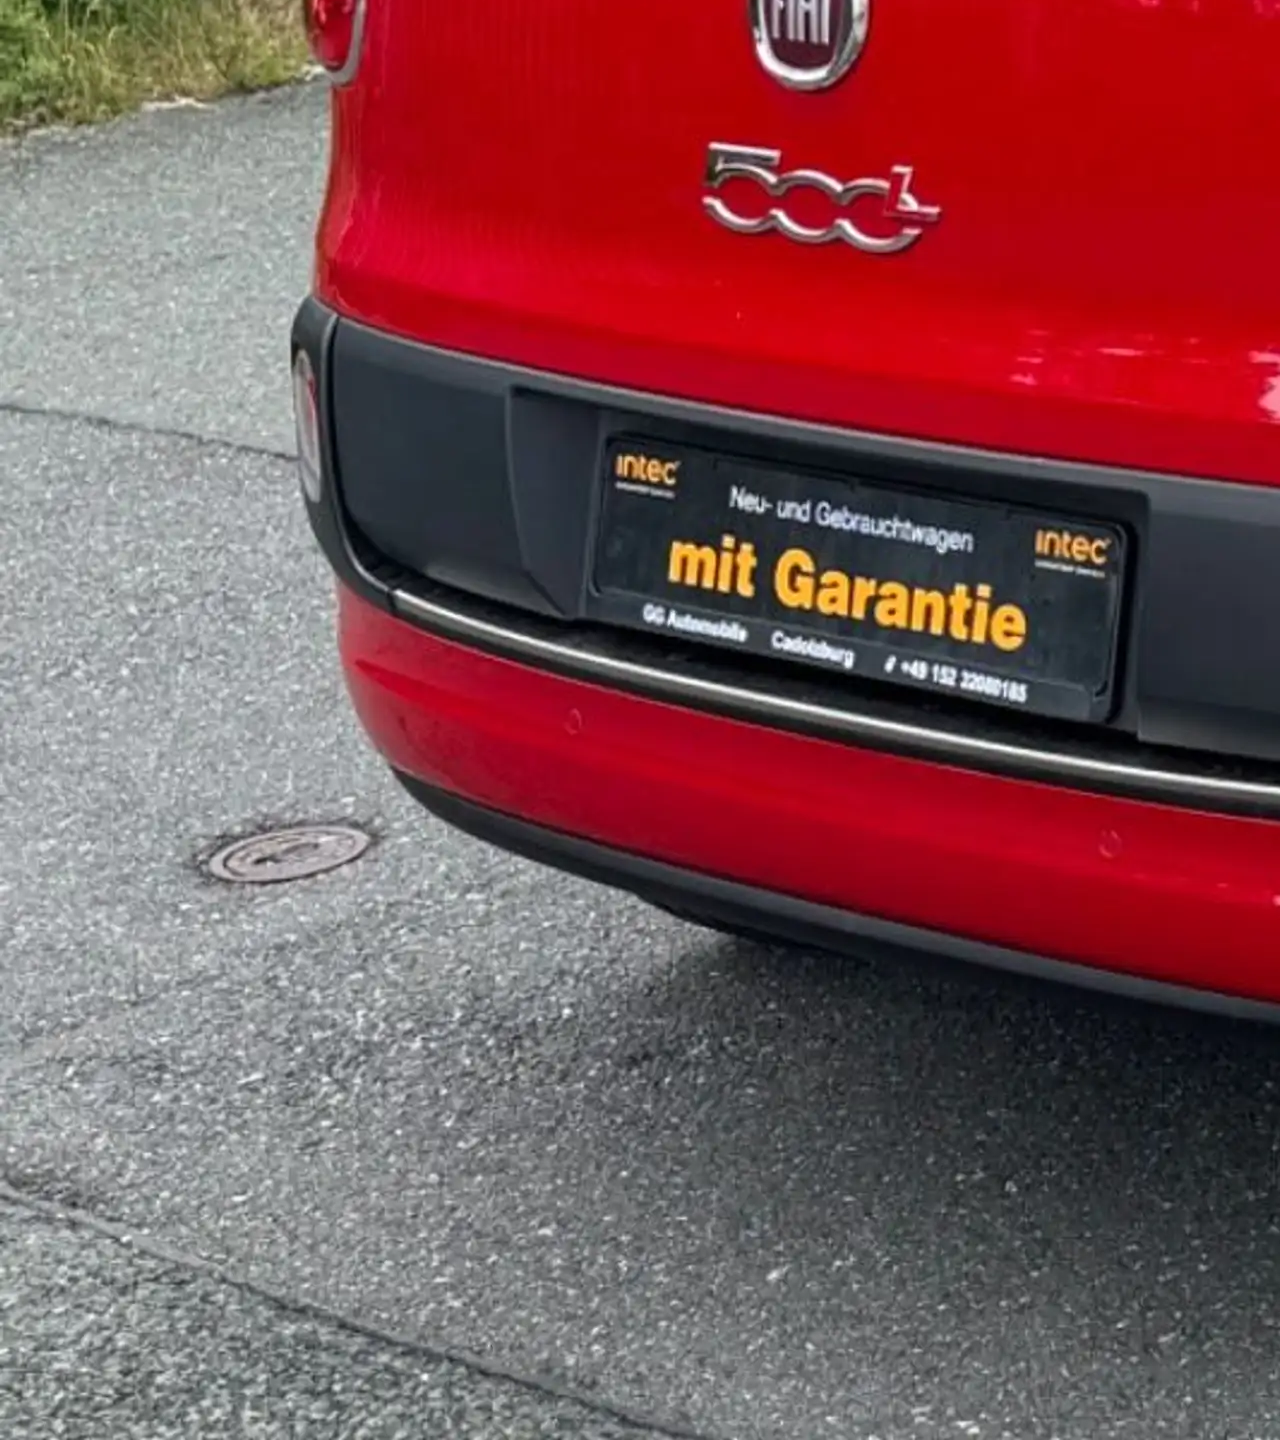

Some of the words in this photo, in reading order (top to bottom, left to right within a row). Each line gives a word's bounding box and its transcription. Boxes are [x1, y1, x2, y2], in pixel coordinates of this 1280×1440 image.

[702, 141, 943, 253] 500L
[615, 453, 679, 486] intec
[728, 484, 773, 515] Neu-
[777, 498, 811, 524] und
[815, 500, 975, 556] Gebrauchtwagen
[1035, 528, 1109, 566] intec
[667, 534, 757, 598] mit
[774, 547, 1028, 652] Garantie
[666, 609, 749, 643] Automobile
